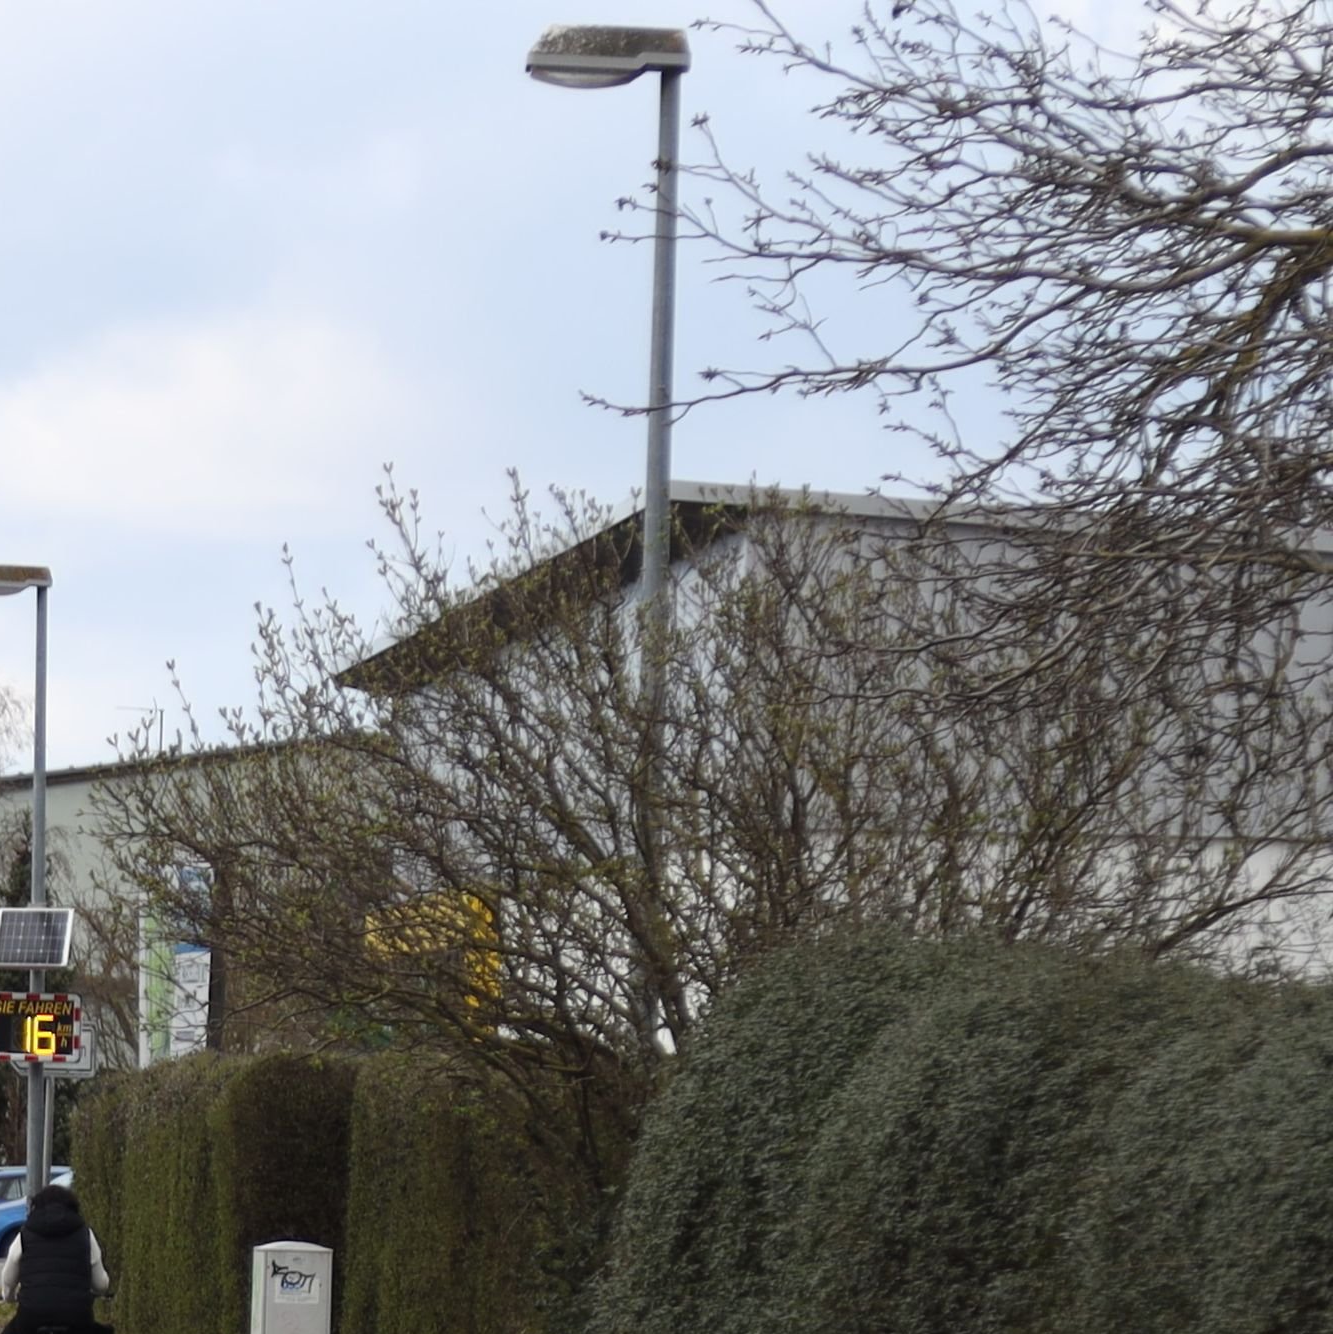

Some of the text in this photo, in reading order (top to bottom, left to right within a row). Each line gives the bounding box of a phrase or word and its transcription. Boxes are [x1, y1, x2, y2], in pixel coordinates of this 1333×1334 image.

[18, 1001, 72, 1015] FAHREN
[57, 1022, 72, 1032] km
[25, 1014, 56, 1056] 16
